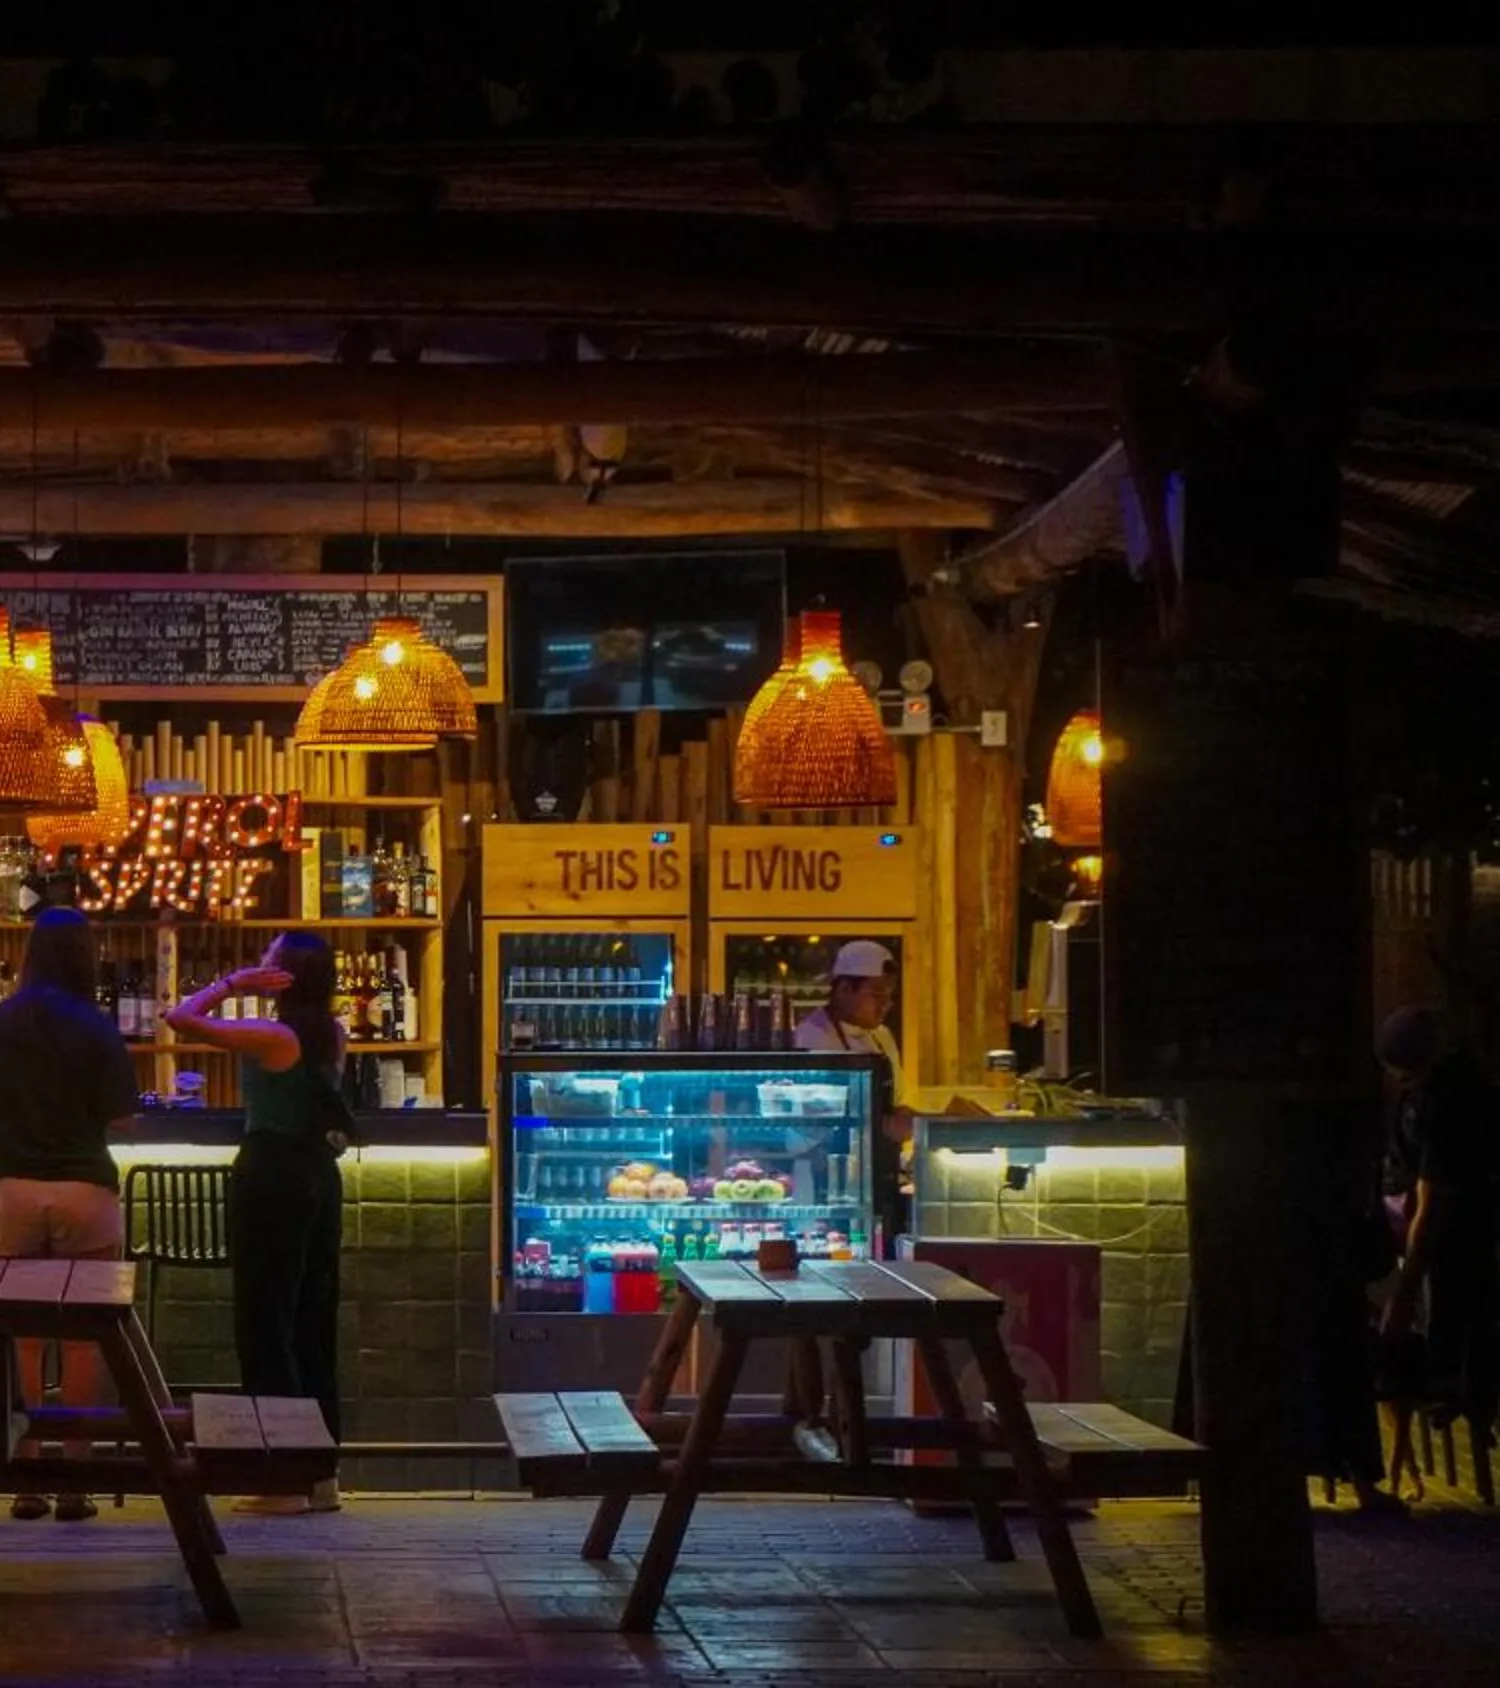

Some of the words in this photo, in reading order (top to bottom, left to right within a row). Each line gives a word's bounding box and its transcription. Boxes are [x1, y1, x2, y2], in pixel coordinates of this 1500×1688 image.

[94, 790, 315, 858] PEROL
[554, 849, 639, 893] THIS
[648, 849, 683, 891] IS
[721, 846, 842, 893] LIVING
